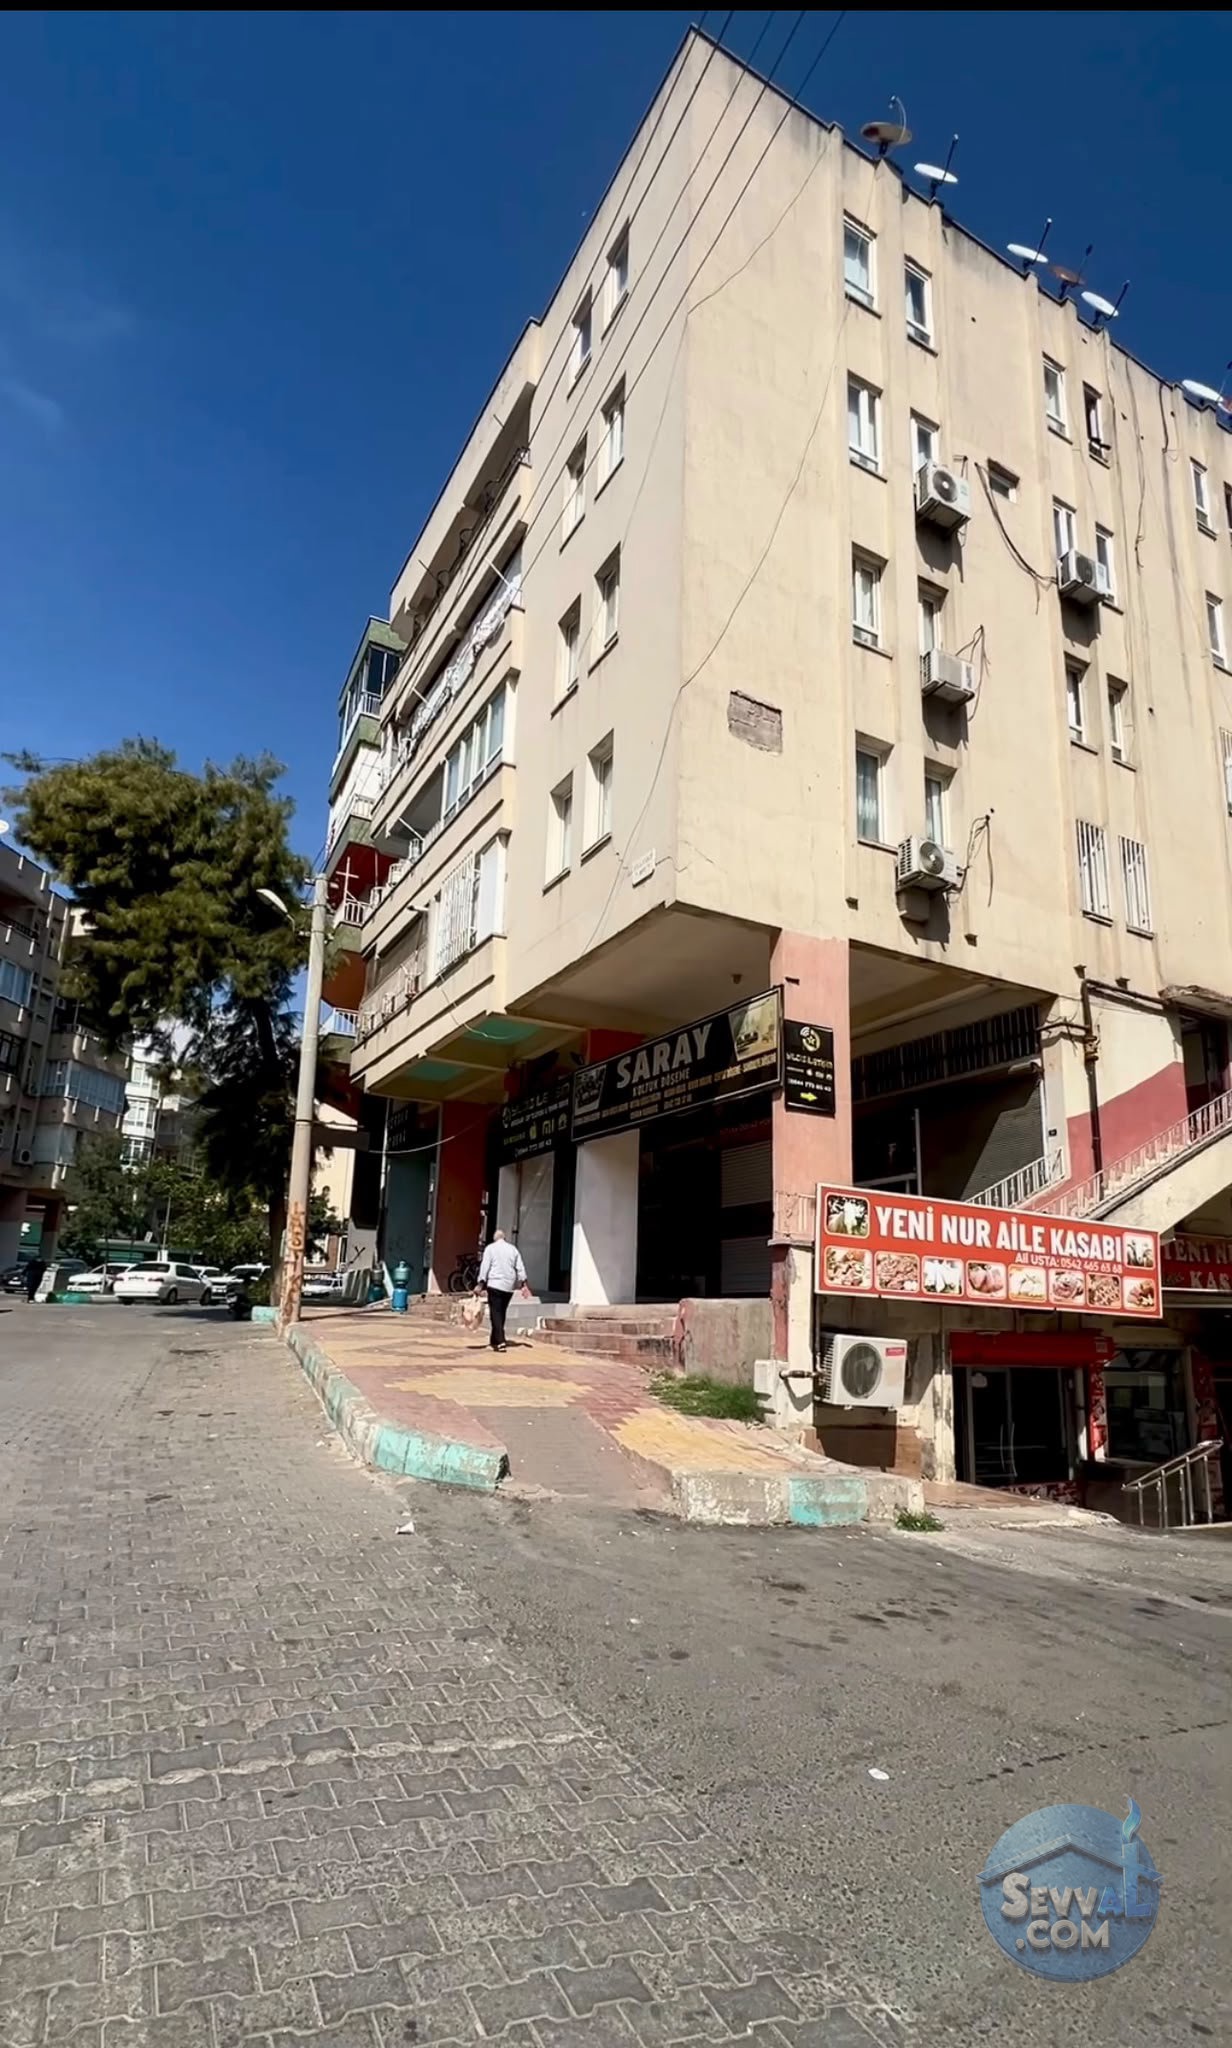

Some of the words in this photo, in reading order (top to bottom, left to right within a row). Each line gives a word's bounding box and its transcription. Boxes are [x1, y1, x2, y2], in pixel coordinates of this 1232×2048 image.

[616, 1022, 713, 1089] SARAY
[875, 1205, 935, 1242] YENİ
[941, 1214, 992, 1248] NUR
[996, 1217, 1046, 1255] AİLE
[1049, 1227, 1122, 1264] KASABI
[1031, 1254, 1060, 1267] USTA:
[1061, 1257, 1082, 1270] 0542
[1083, 1261, 1099, 1272] 465
